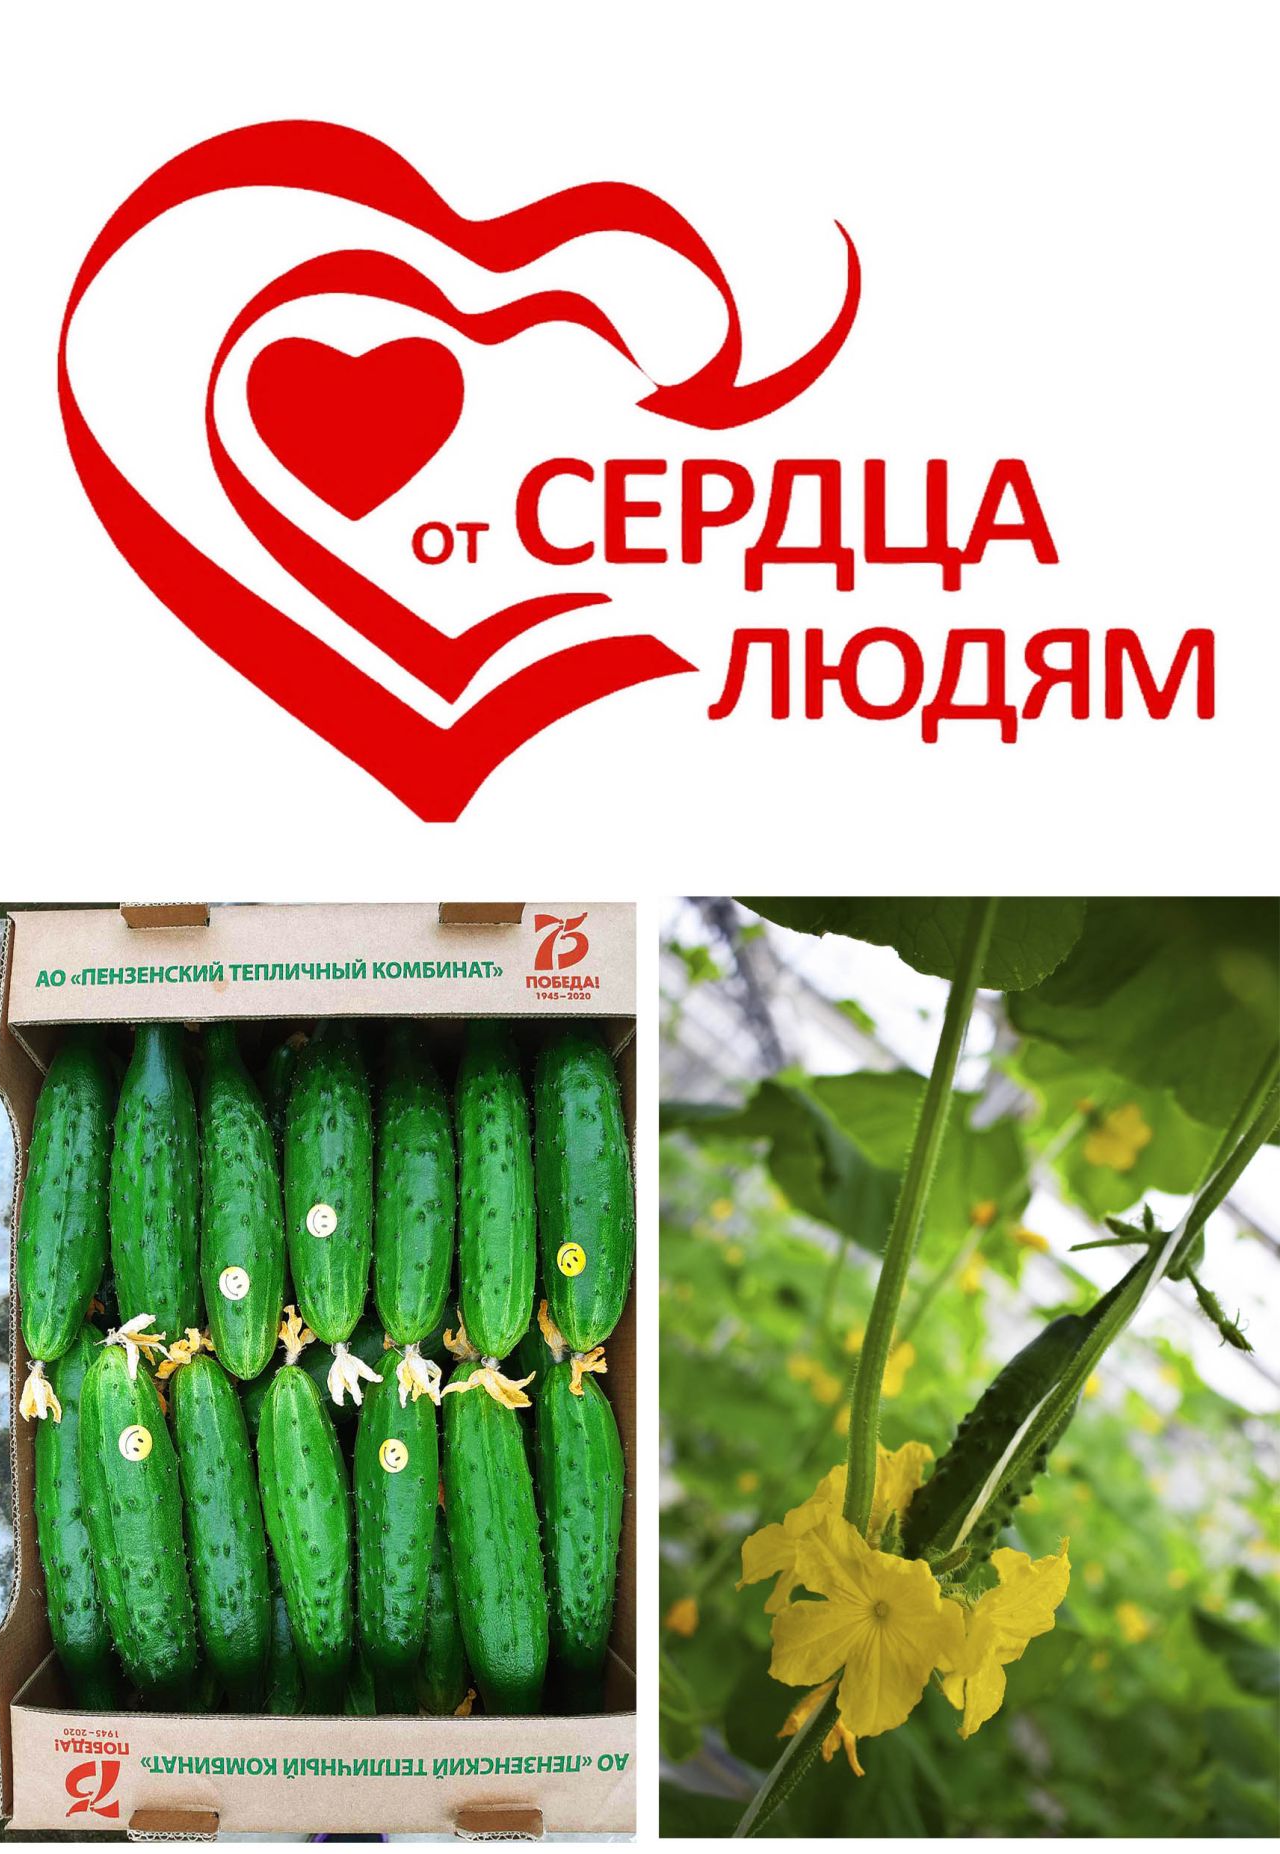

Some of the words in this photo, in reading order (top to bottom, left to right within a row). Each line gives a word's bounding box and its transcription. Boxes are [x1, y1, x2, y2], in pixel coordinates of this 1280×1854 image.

[515, 457, 1060, 592] СЕРДЦА
[708, 626, 1215, 744] ЛЮДЯМ
[35, 969, 67, 988] АО
[70, 960, 225, 986] «ПЕНЗЕНСКИЙ
[228, 958, 367, 983] ТЕПЛИЧНЫЙ
[372, 960, 504, 980] КОМБИНАТ»
[525, 975, 601, 990] ПОБЕДА!
[54, 1739, 130, 1756] ПОБЕДА!
[140, 1755, 277, 1777] КОМБИНАТ»
[283, 1757, 428, 1780] ТЕПЛИЧНЫЙ
[433, 1755, 592, 1780] «ПЕНЗЕНСКИЙ
[596, 1752, 630, 1772] АО
